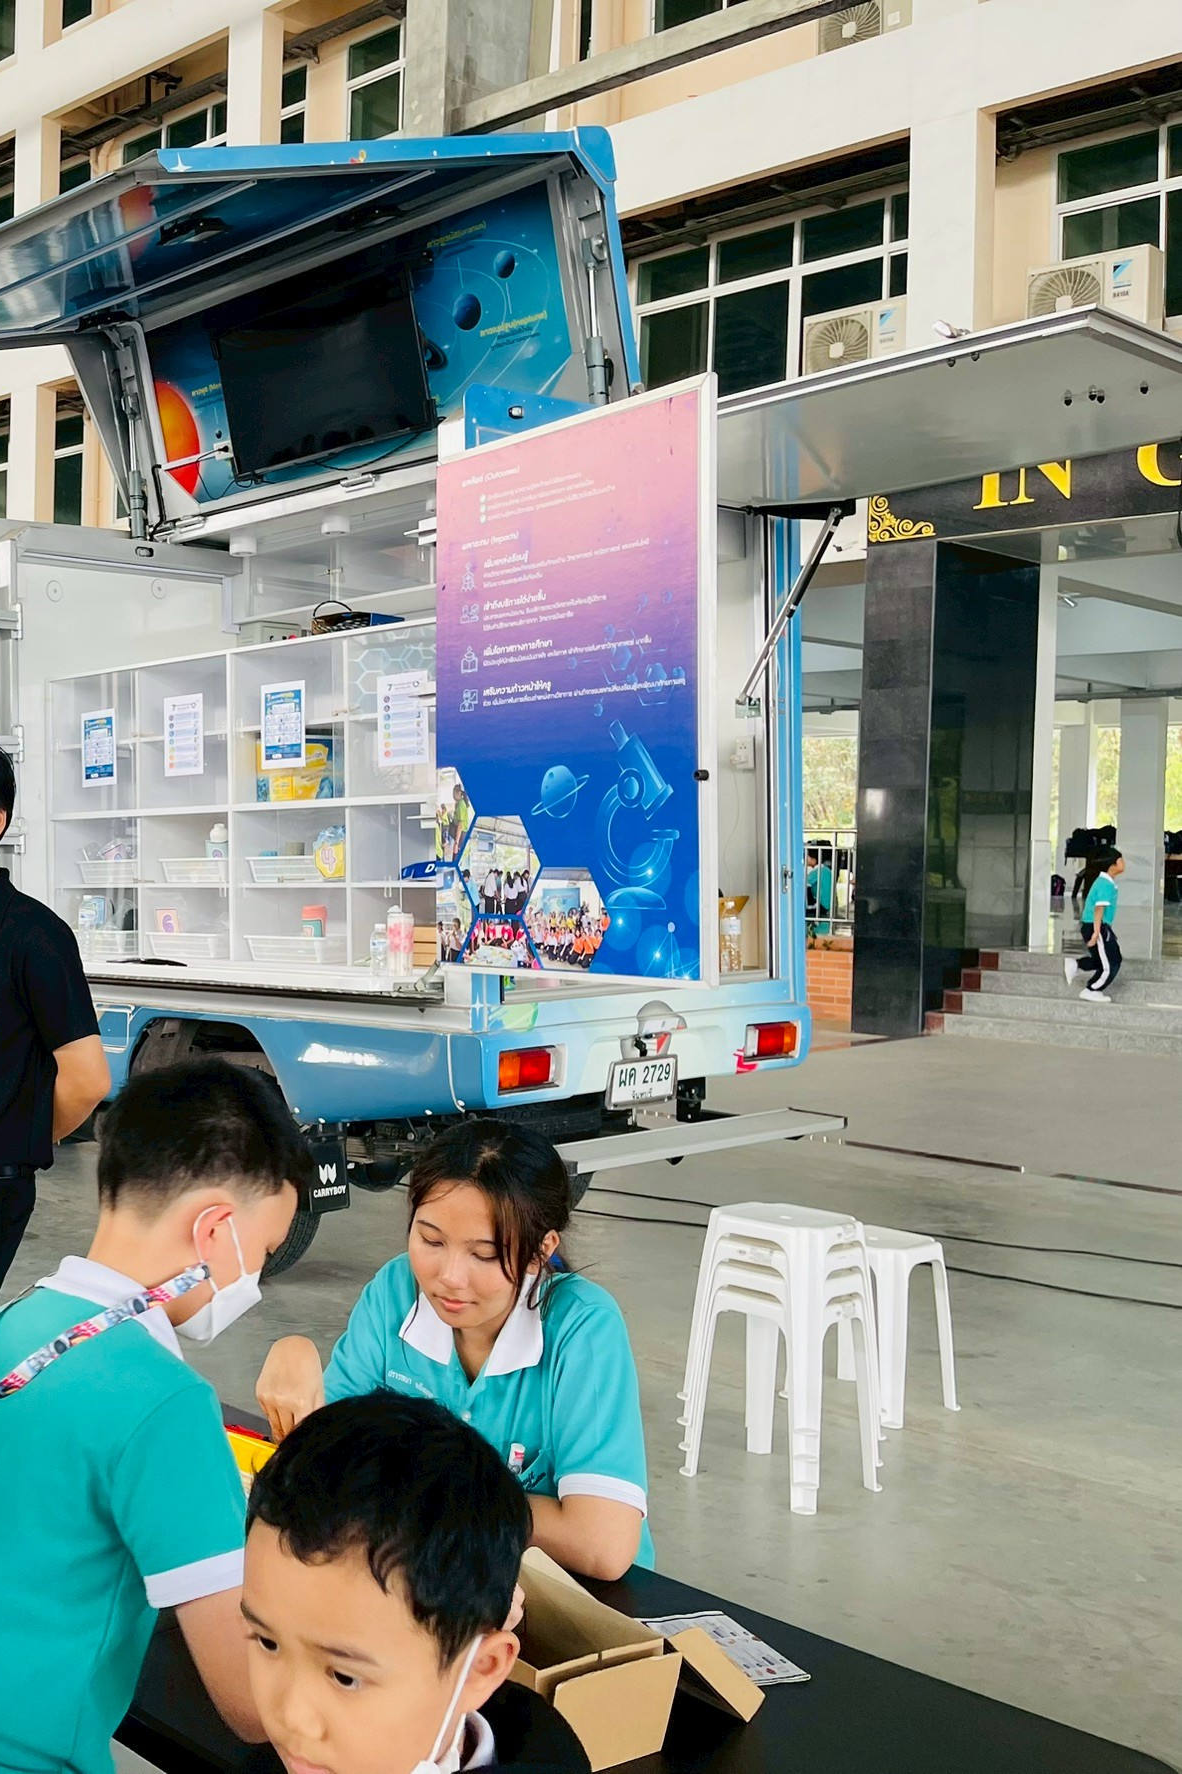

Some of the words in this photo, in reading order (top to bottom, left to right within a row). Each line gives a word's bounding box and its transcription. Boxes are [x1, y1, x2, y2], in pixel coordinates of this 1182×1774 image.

[483, 588, 547, 611] เข้าถึงบริการได้ง่ายขึ้น
[483, 638, 553, 656] เพิ่มโอกาสทางการศึกษา
[483, 680, 552, 697] เสริมความก้าวหน้าให้ครู
[320, 847, 337, 872] 4
[162, 914, 175, 933] 6
[641, 1062, 671, 1085] 2729
[313, 1184, 347, 1198] CARRYBOY
